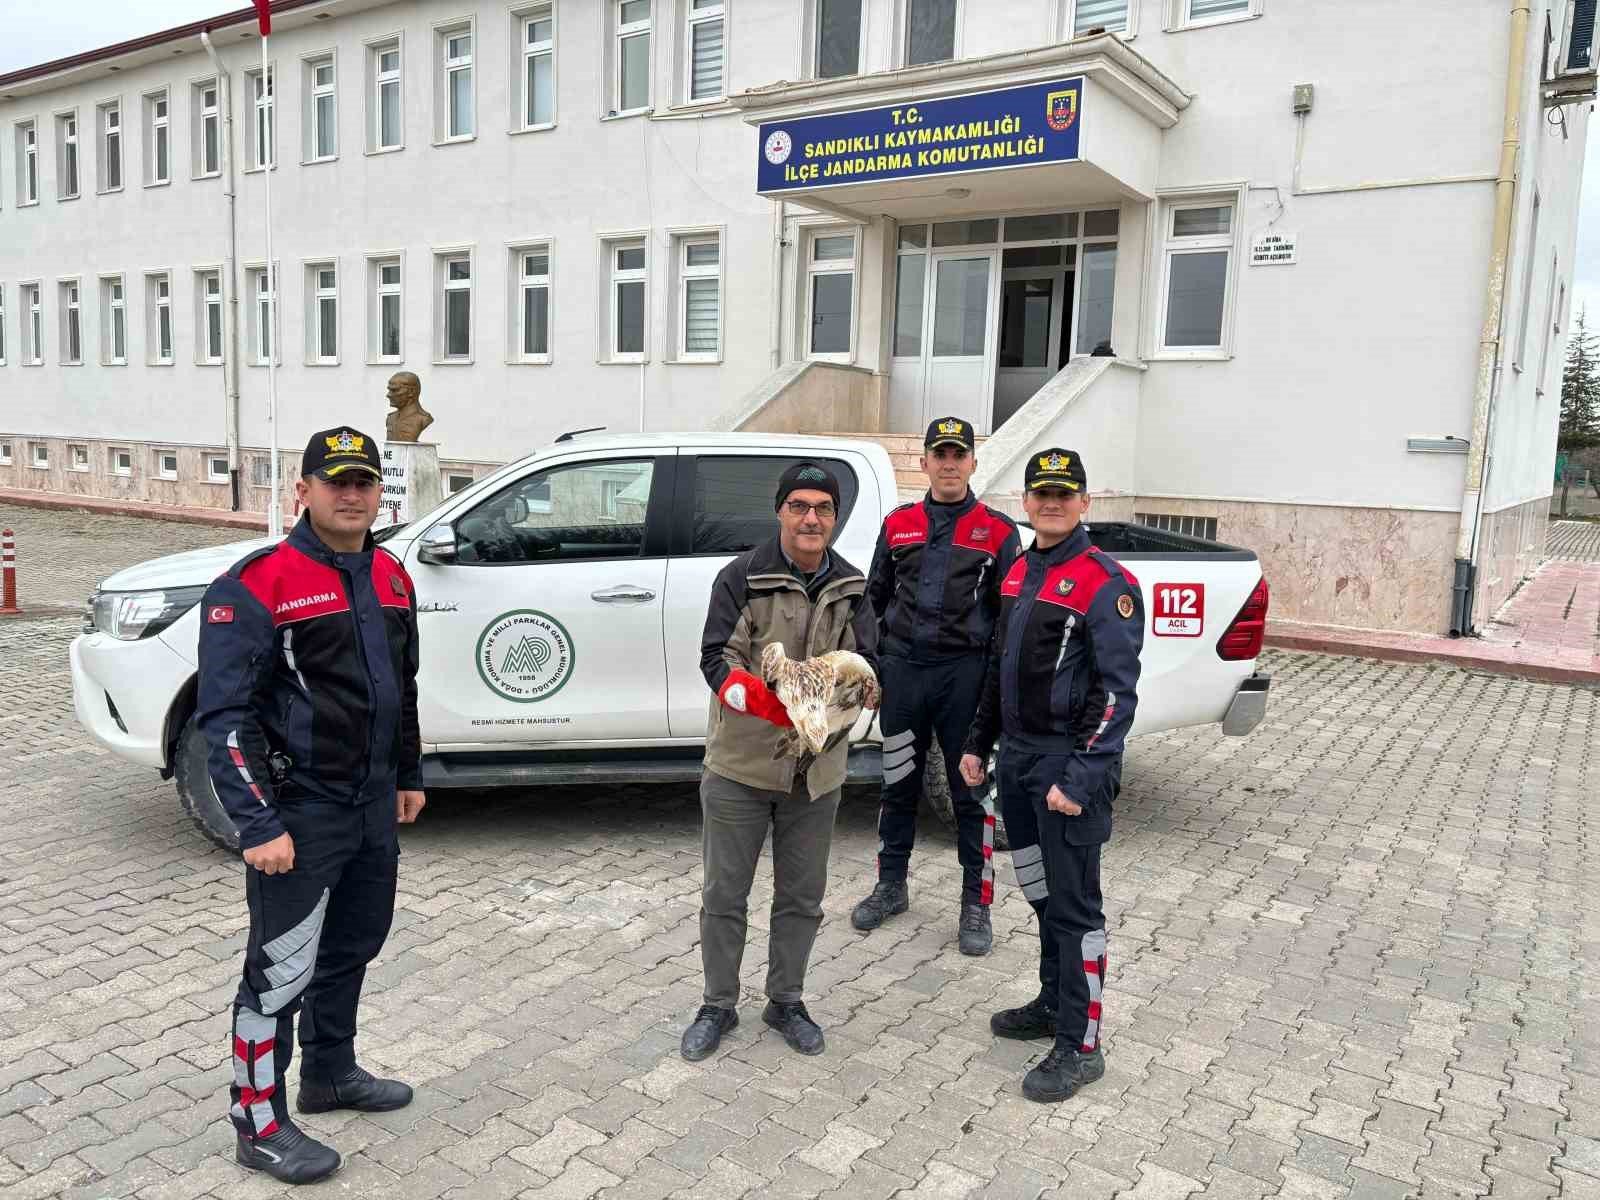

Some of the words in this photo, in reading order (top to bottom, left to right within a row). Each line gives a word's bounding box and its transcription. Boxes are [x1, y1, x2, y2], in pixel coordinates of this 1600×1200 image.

[892, 107, 923, 125] T.C.
[804, 135, 879, 159] SANDIKLI
[884, 114, 1021, 149] KAYMAKAMLIĞI
[785, 162, 819, 183] İLÇE
[823, 154, 912, 177] JANDARMA
[918, 134, 1045, 168] KOMUTANLIĞI
[383, 450, 393, 460] NE
[382, 467, 404, 477] MUTLU
[275, 591, 338, 614] JANDARMA
[1160, 588, 1197, 615] 112
[513, 617, 552, 631] PARKLAR
